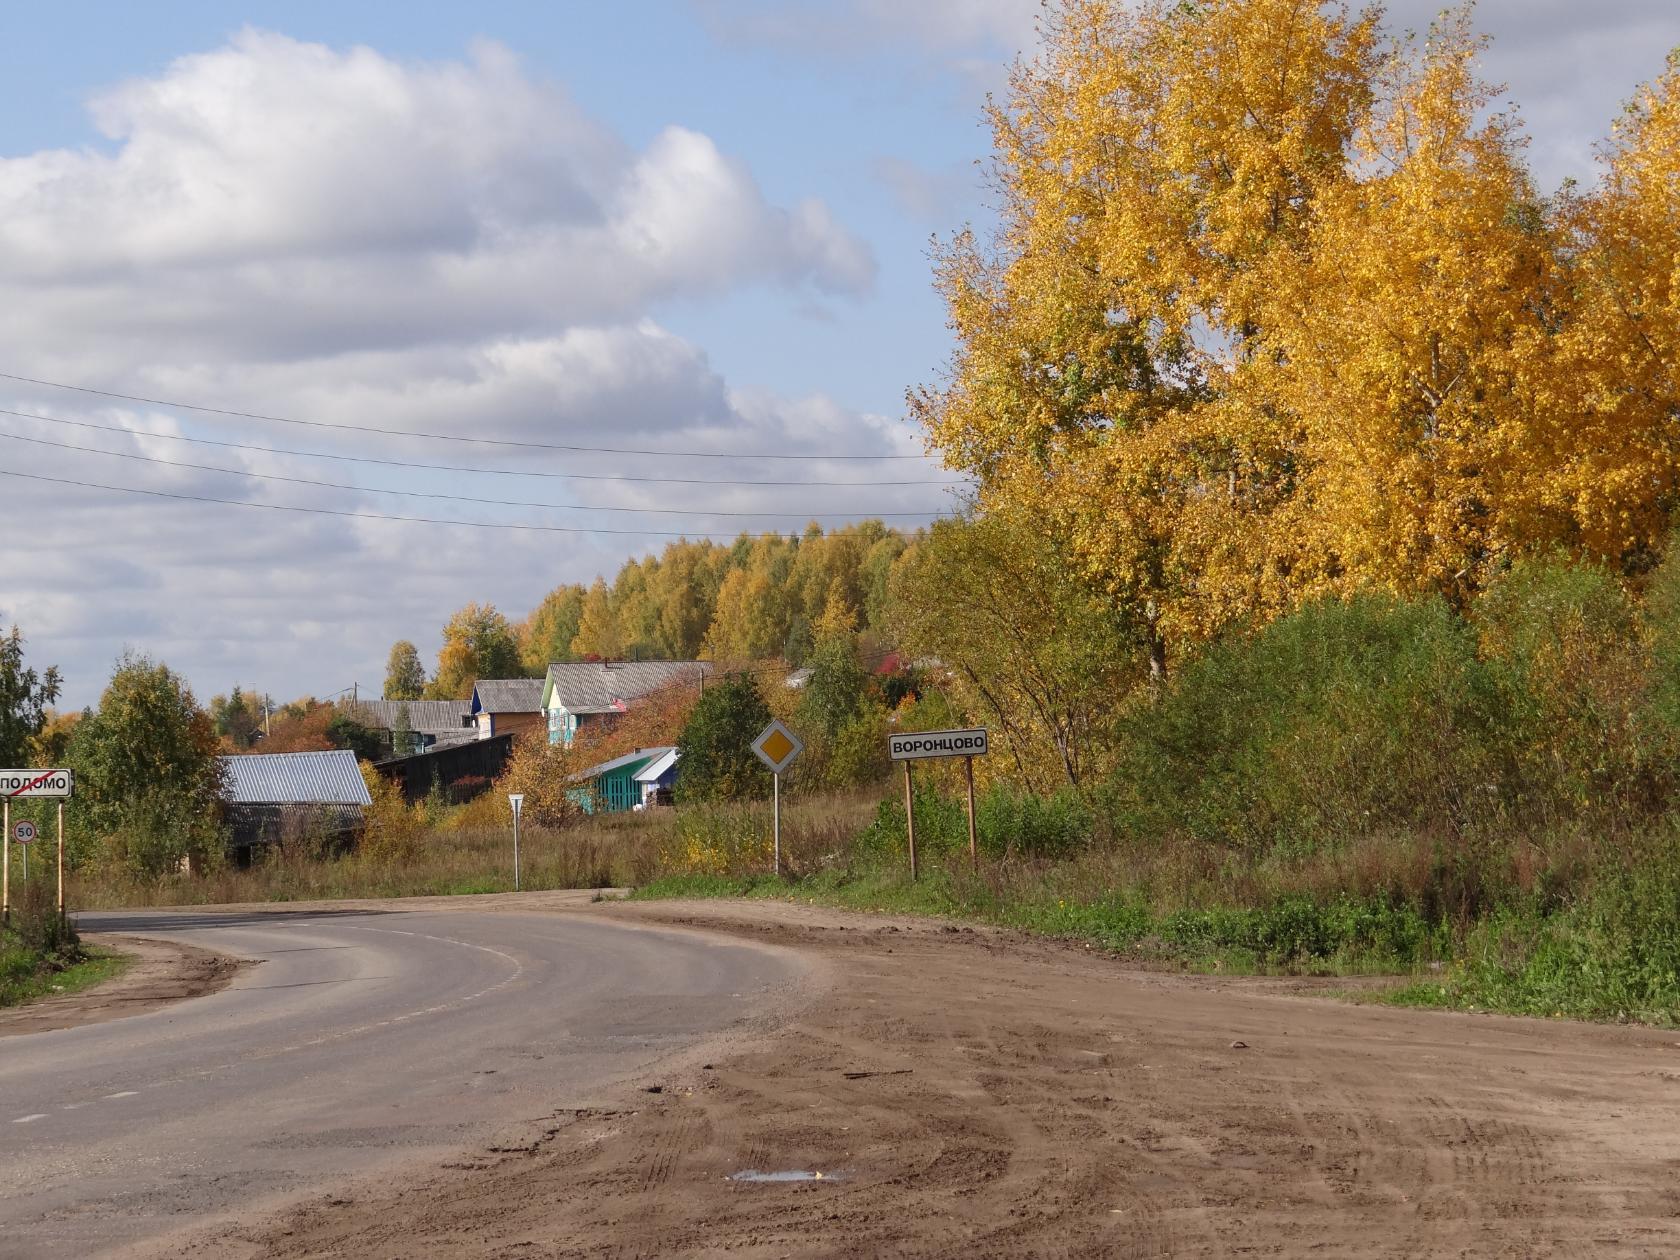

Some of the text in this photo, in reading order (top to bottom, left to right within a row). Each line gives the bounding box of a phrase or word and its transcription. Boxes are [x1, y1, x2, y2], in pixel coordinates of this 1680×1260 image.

[893, 736, 984, 753] ВОРОНЦОВО
[0, 777, 66, 790] ПОДОМО
[17, 827, 33, 837] 50
